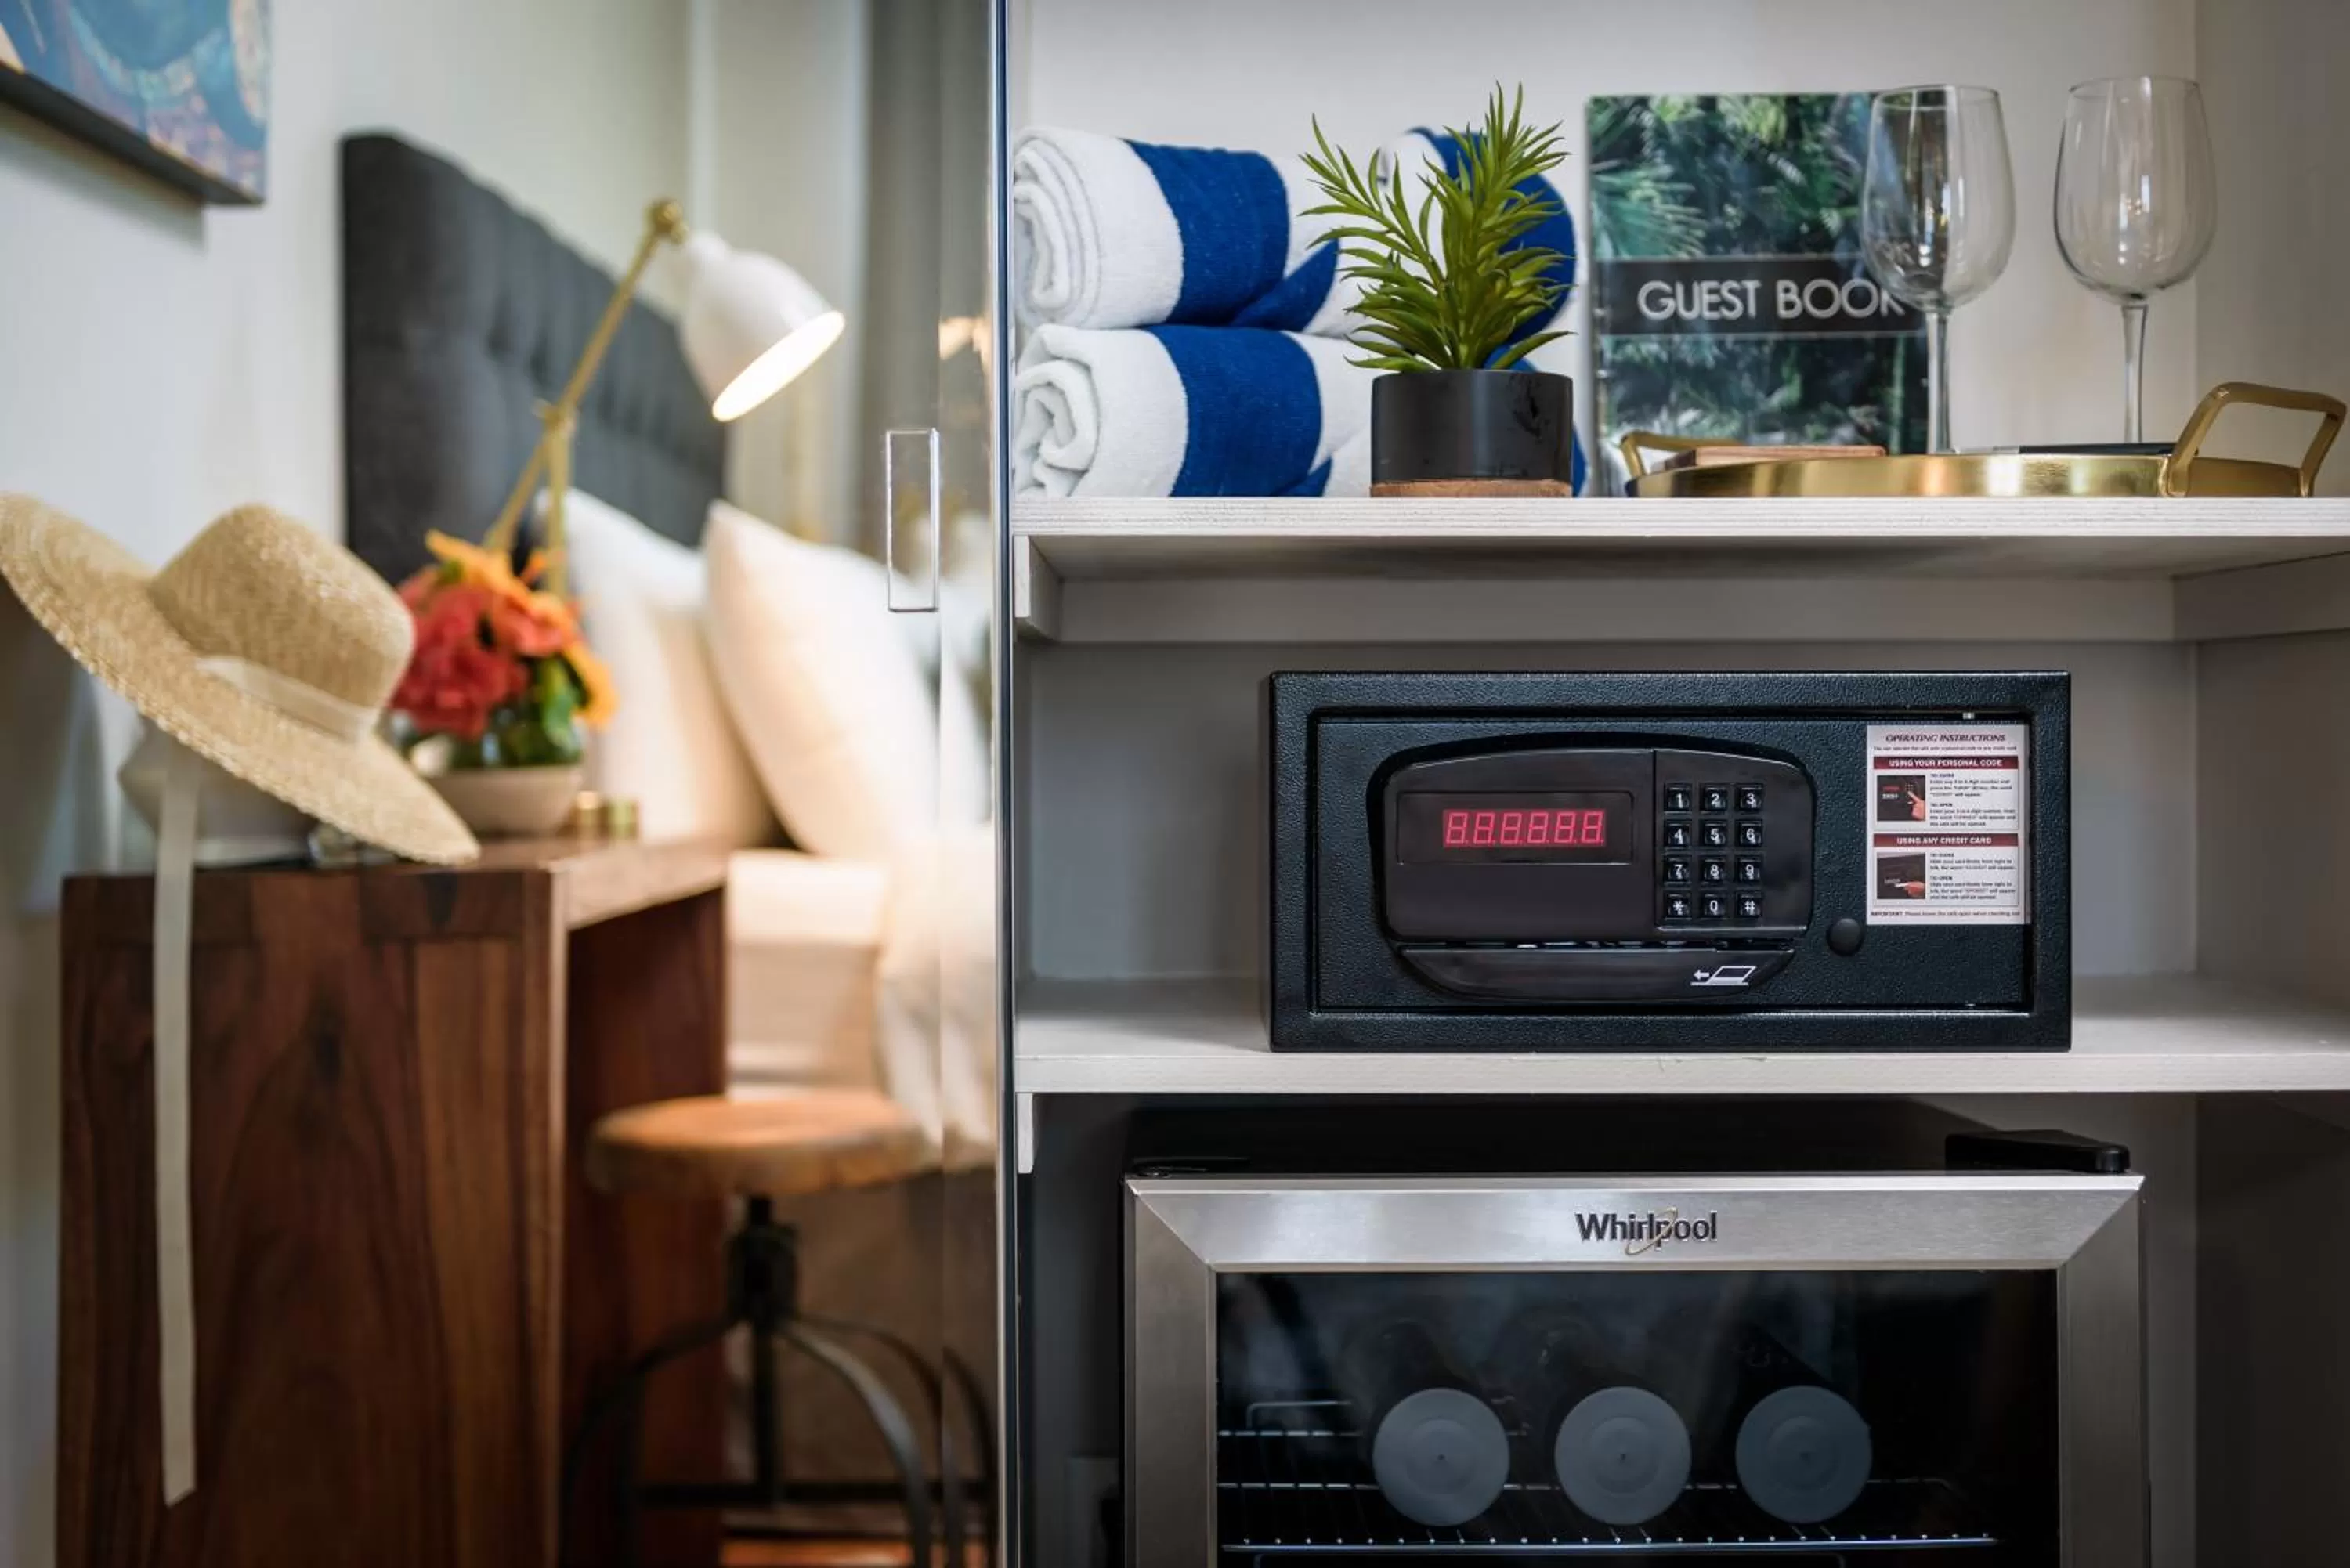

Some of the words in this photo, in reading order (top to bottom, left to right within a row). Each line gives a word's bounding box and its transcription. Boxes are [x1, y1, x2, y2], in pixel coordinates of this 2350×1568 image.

[1637, 279, 1761, 320] GUEST
[1885, 734, 1938, 742] OPERATING
[1939, 734, 2006, 742] INSTRUCTIONS
[1889, 758, 1913, 767] USING
[1915, 758, 1936, 767] YOUR
[1937, 758, 1979, 767] PERSONAL
[1980, 758, 2003, 767] CODE
[1676, 793, 1683, 807] 1
[1711, 793, 1721, 806] 2
[1746, 793, 1755, 806] 3
[1674, 828, 1683, 842] 4
[1710, 828, 1720, 842] 5
[1746, 828, 1755, 842] 6
[1674, 864, 1683, 878] 7
[1710, 864, 1719, 878] 8
[1745, 864, 1755, 878] 9
[1574, 1212, 1718, 1249] Whirlpool
